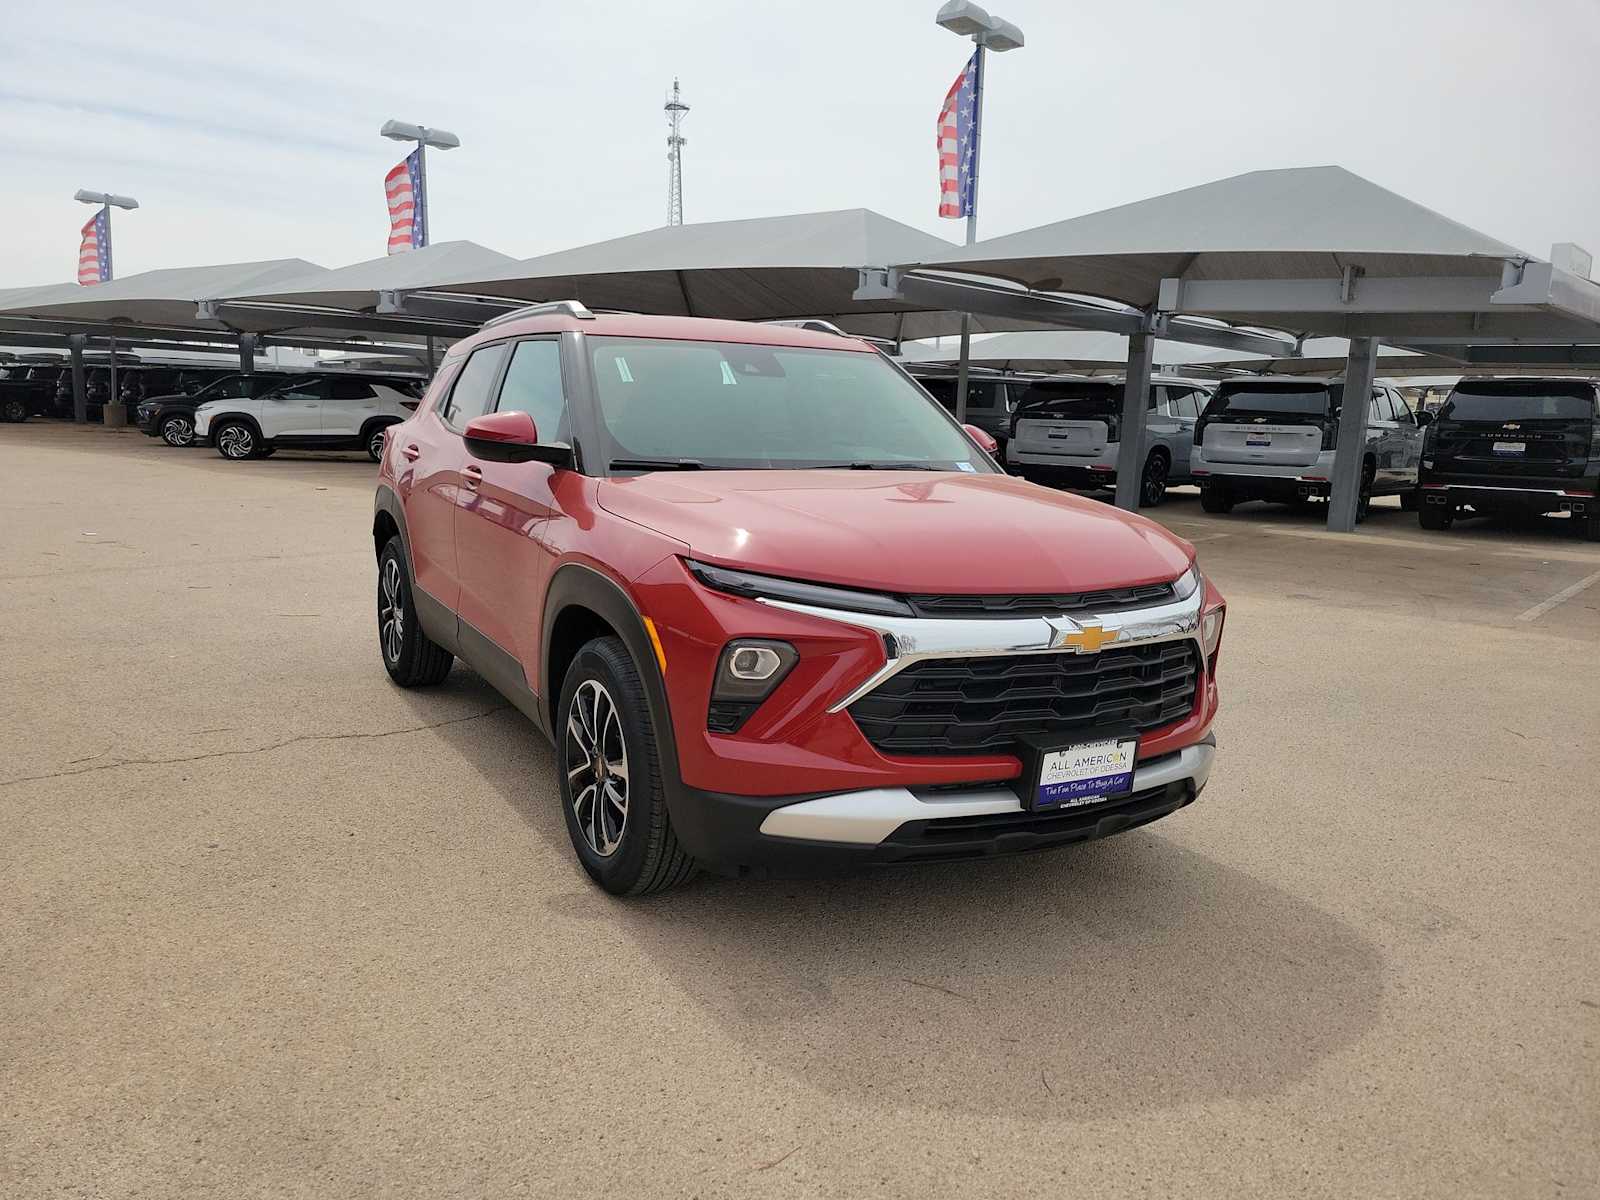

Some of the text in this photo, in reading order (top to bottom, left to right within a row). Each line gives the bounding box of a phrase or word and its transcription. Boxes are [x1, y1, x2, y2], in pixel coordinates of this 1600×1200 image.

[1047, 763, 1127, 780] CHEVROLET OF ODESSA
[1050, 760, 1070, 771] ALL
[1045, 786, 1057, 796] The
[1070, 782, 1087, 792] Place
[1087, 780, 1095, 789] To
[1096, 779, 1107, 790] Buy
[1114, 776, 1125, 785] Car
